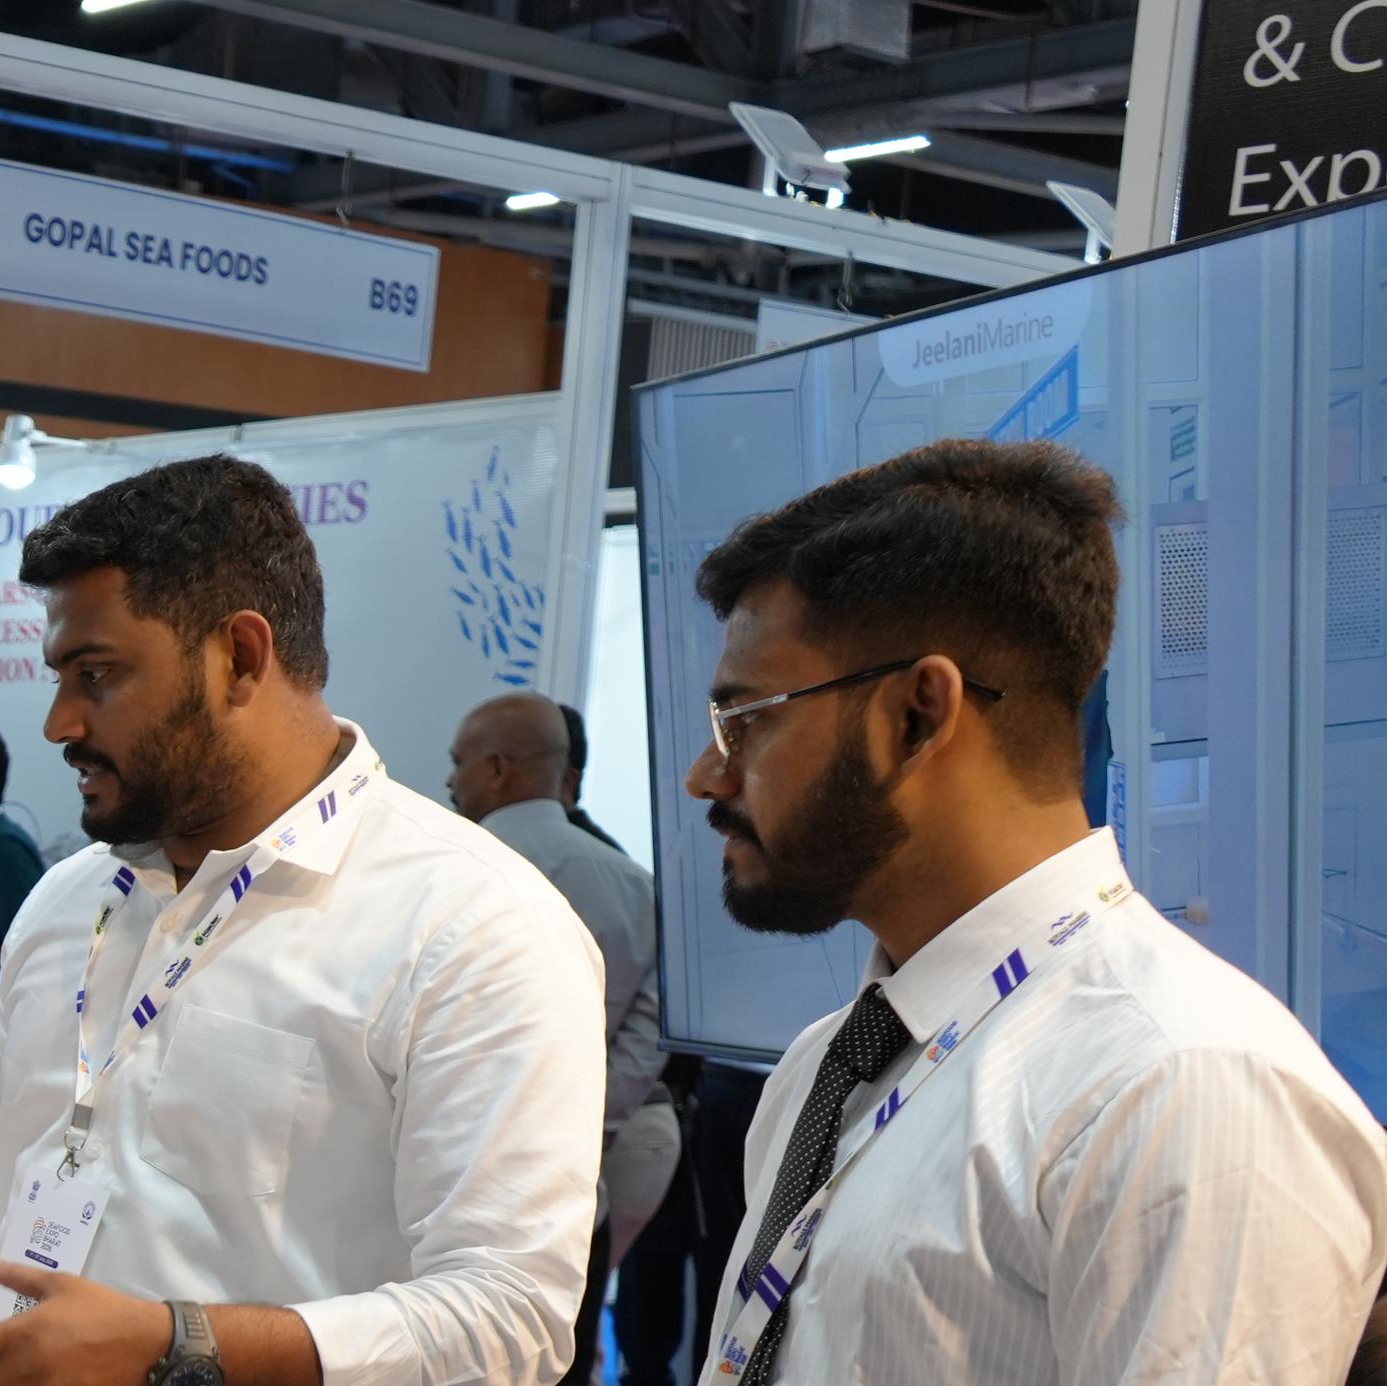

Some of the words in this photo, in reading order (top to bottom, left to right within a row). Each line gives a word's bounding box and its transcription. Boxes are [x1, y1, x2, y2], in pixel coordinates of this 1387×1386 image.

[1243, 14, 1307, 88] &
[1228, 143, 1387, 217] Exp
[24, 212, 118, 258] GOPAL
[125, 230, 174, 268] SEA
[180, 244, 270, 285] FOODS
[369, 277, 419, 316] B69
[912, 312, 1055, 370] JeelaniMarine
[293, 480, 370, 525] IES
